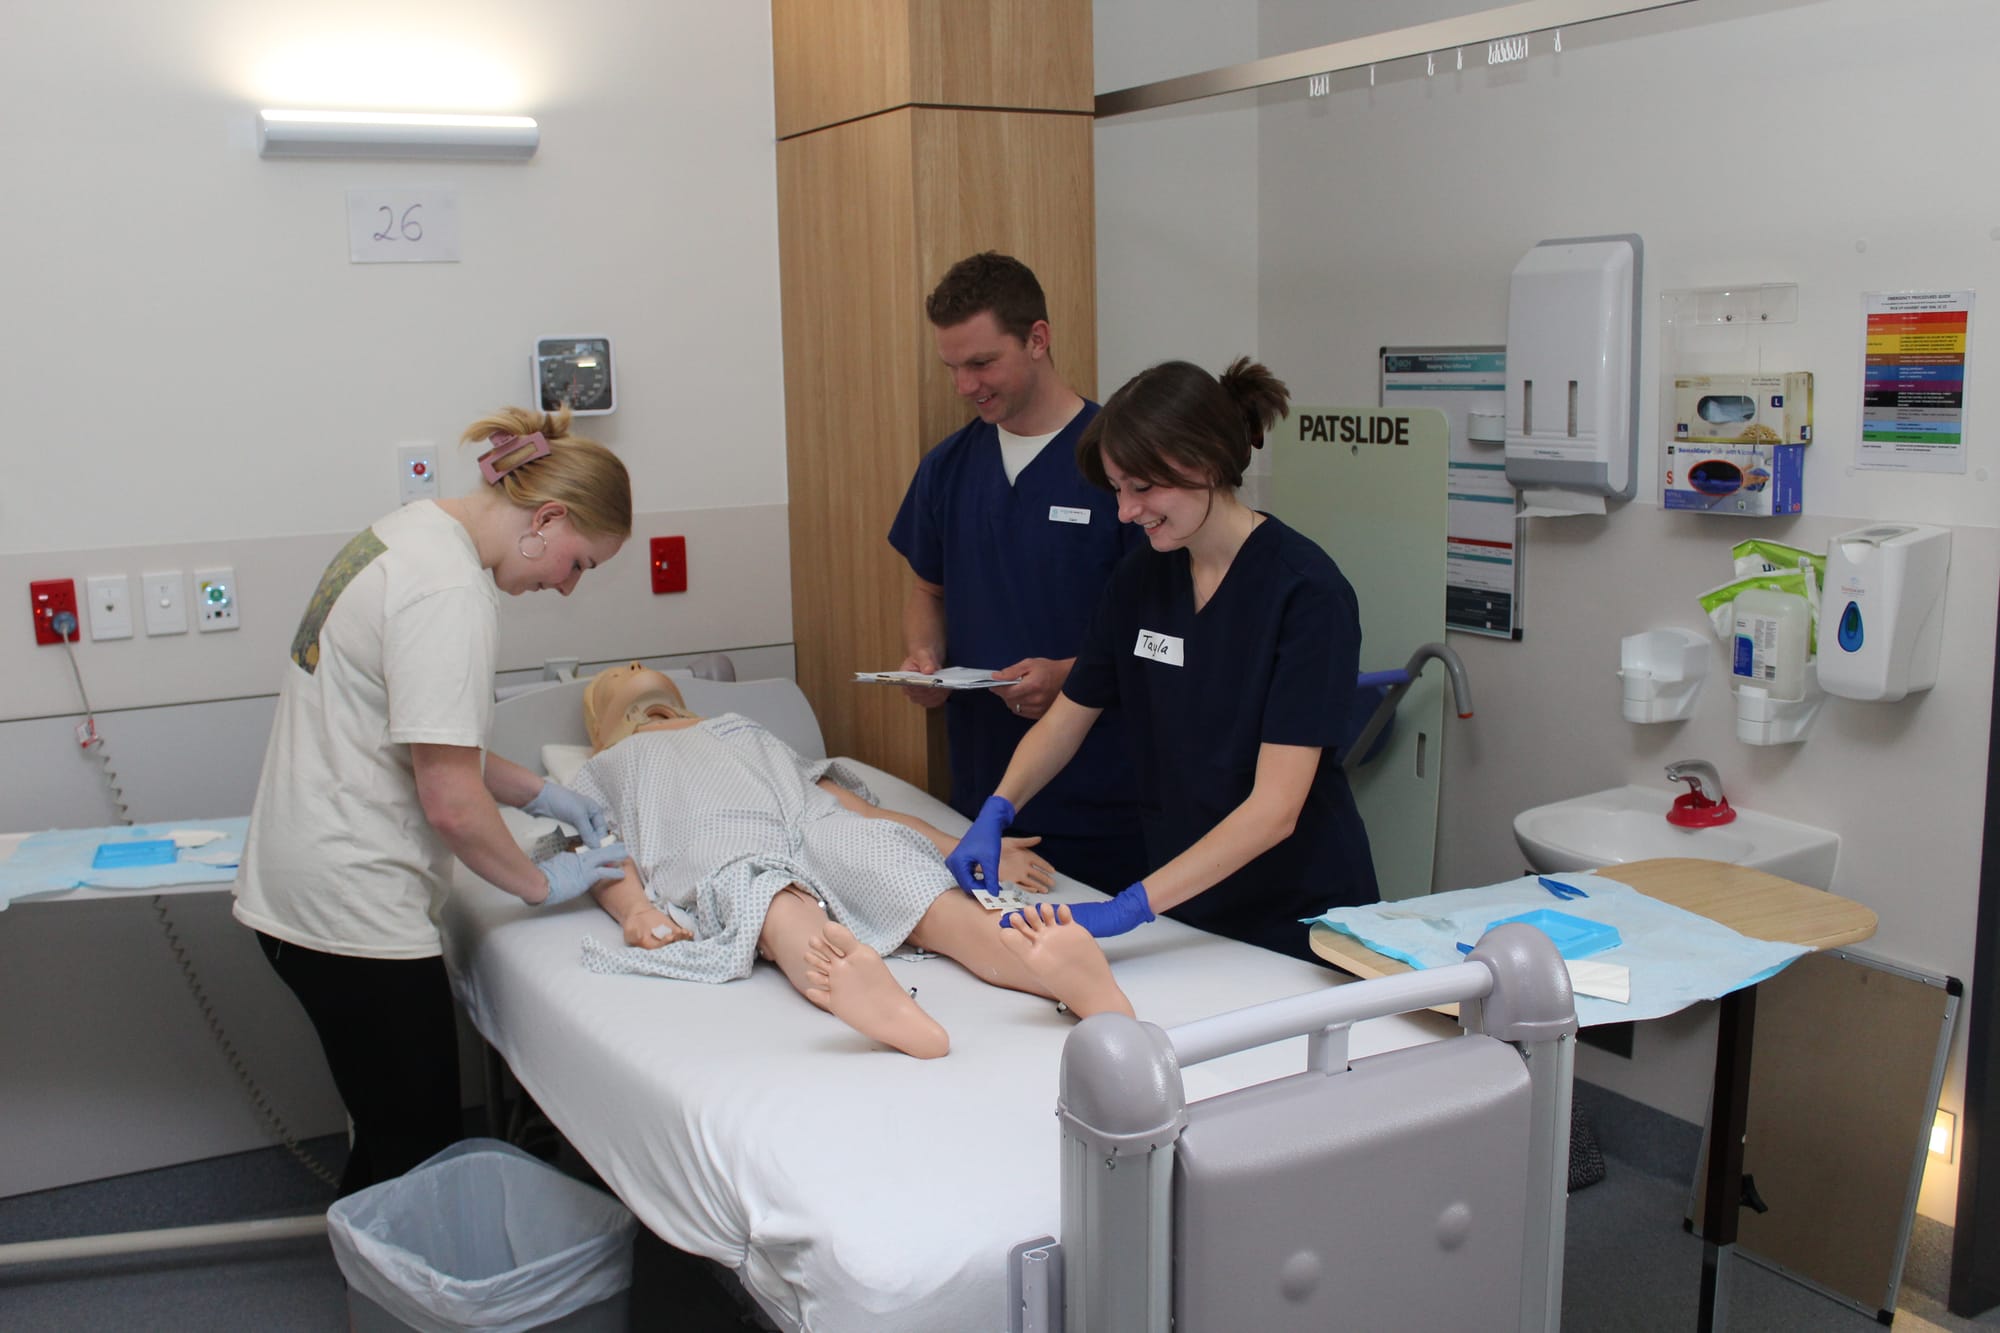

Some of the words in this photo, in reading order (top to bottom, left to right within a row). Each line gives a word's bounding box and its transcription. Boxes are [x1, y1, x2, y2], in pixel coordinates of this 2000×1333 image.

[373, 203, 423, 241] 26
[1774, 398, 1781, 406] L
[1299, 415, 1409, 445] PATSLIDE
[1666, 470, 1674, 485] S
[1143, 635, 1168, 656] Tayla
